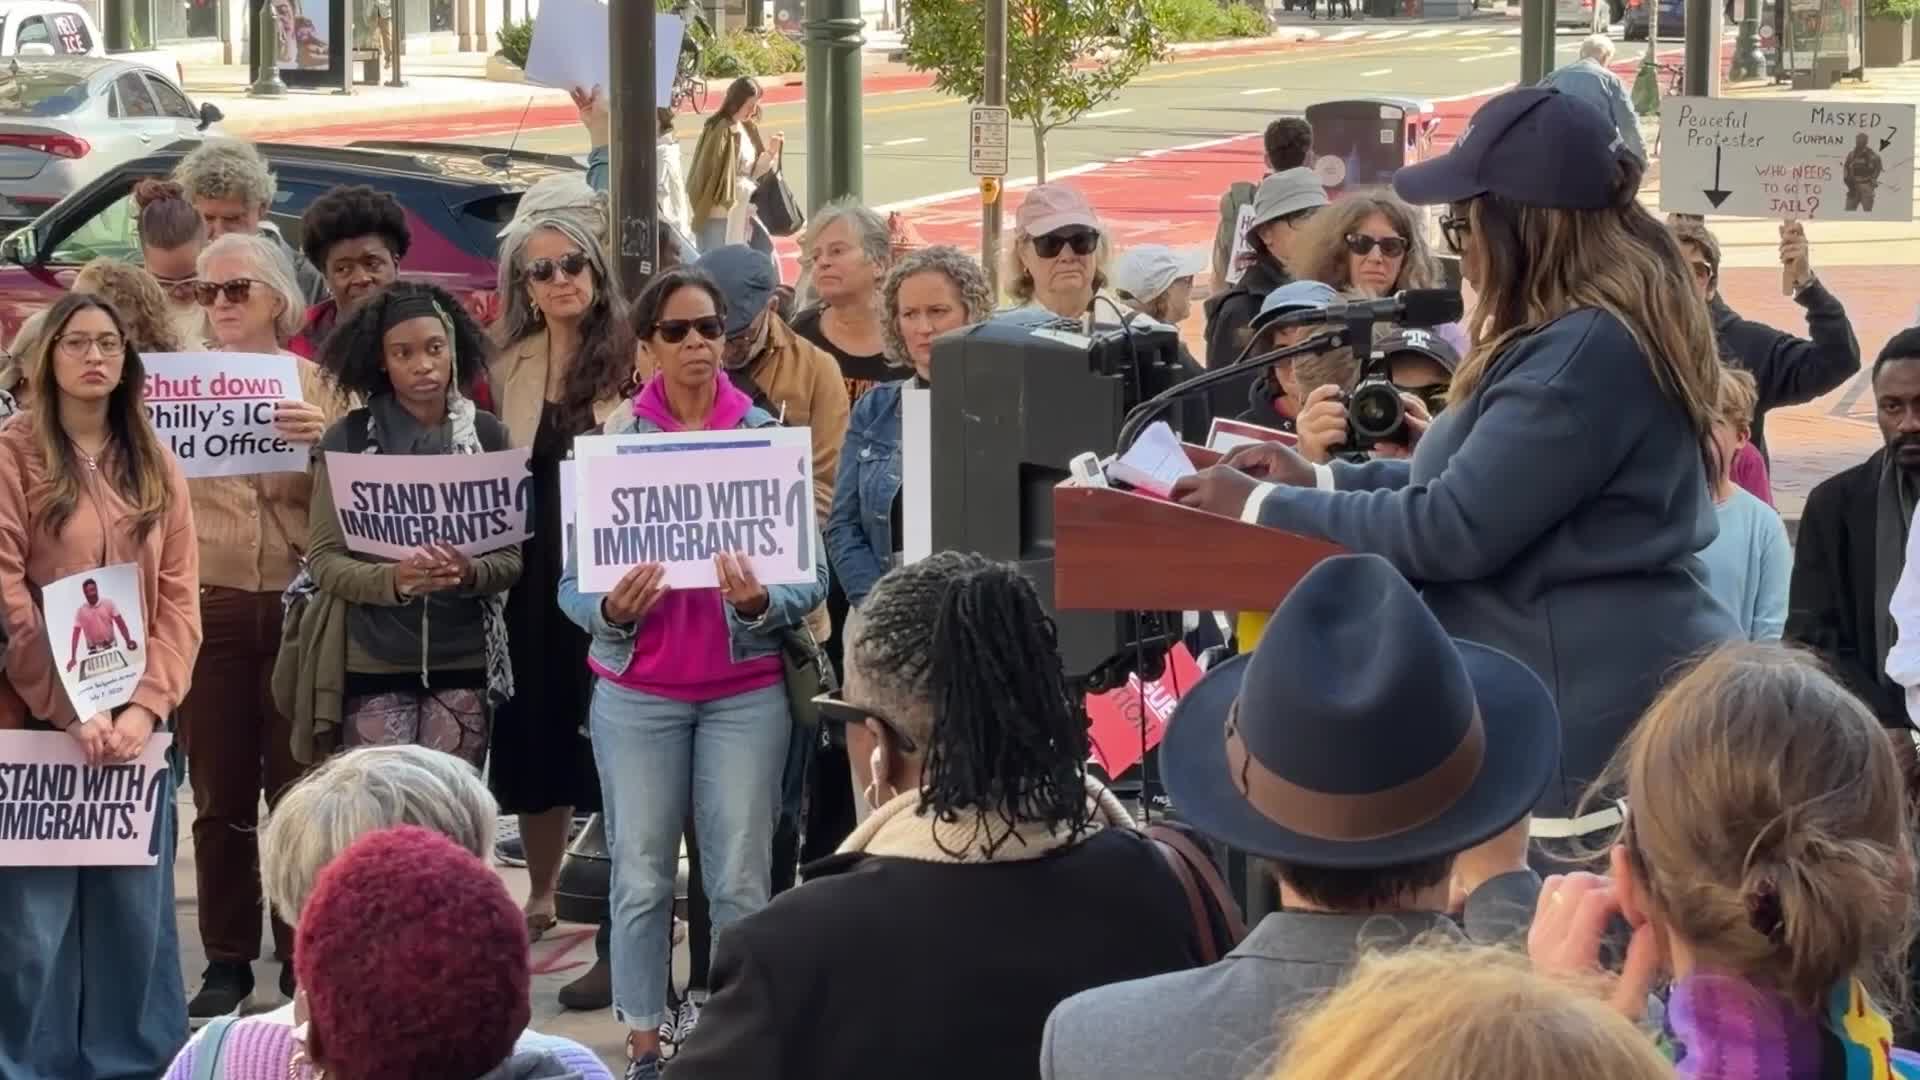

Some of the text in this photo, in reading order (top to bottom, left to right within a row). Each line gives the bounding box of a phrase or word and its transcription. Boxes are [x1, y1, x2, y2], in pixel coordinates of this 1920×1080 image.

[62, 34, 87, 54] ICE
[1678, 104, 1748, 128] Peaceful
[1811, 106, 1881, 128] MASKED
[1687, 128, 1765, 147] Protester
[1792, 130, 1844, 145] GUNMAN
[1754, 164, 1832, 181] WHO NEEDS
[1762, 183, 1822, 194] TO GO TO
[1770, 196, 1820, 219] JAIL?
[143, 371, 284, 398] Shut down
[204, 431, 296, 458] Office.
[351, 476, 512, 516] STAND WITH
[610, 478, 782, 526] STAND WITH
[340, 507, 513, 547] IMMIGRANTS.
[593, 517, 784, 566] IMMIGRANTS.
[83, 763, 146, 801] WITH
